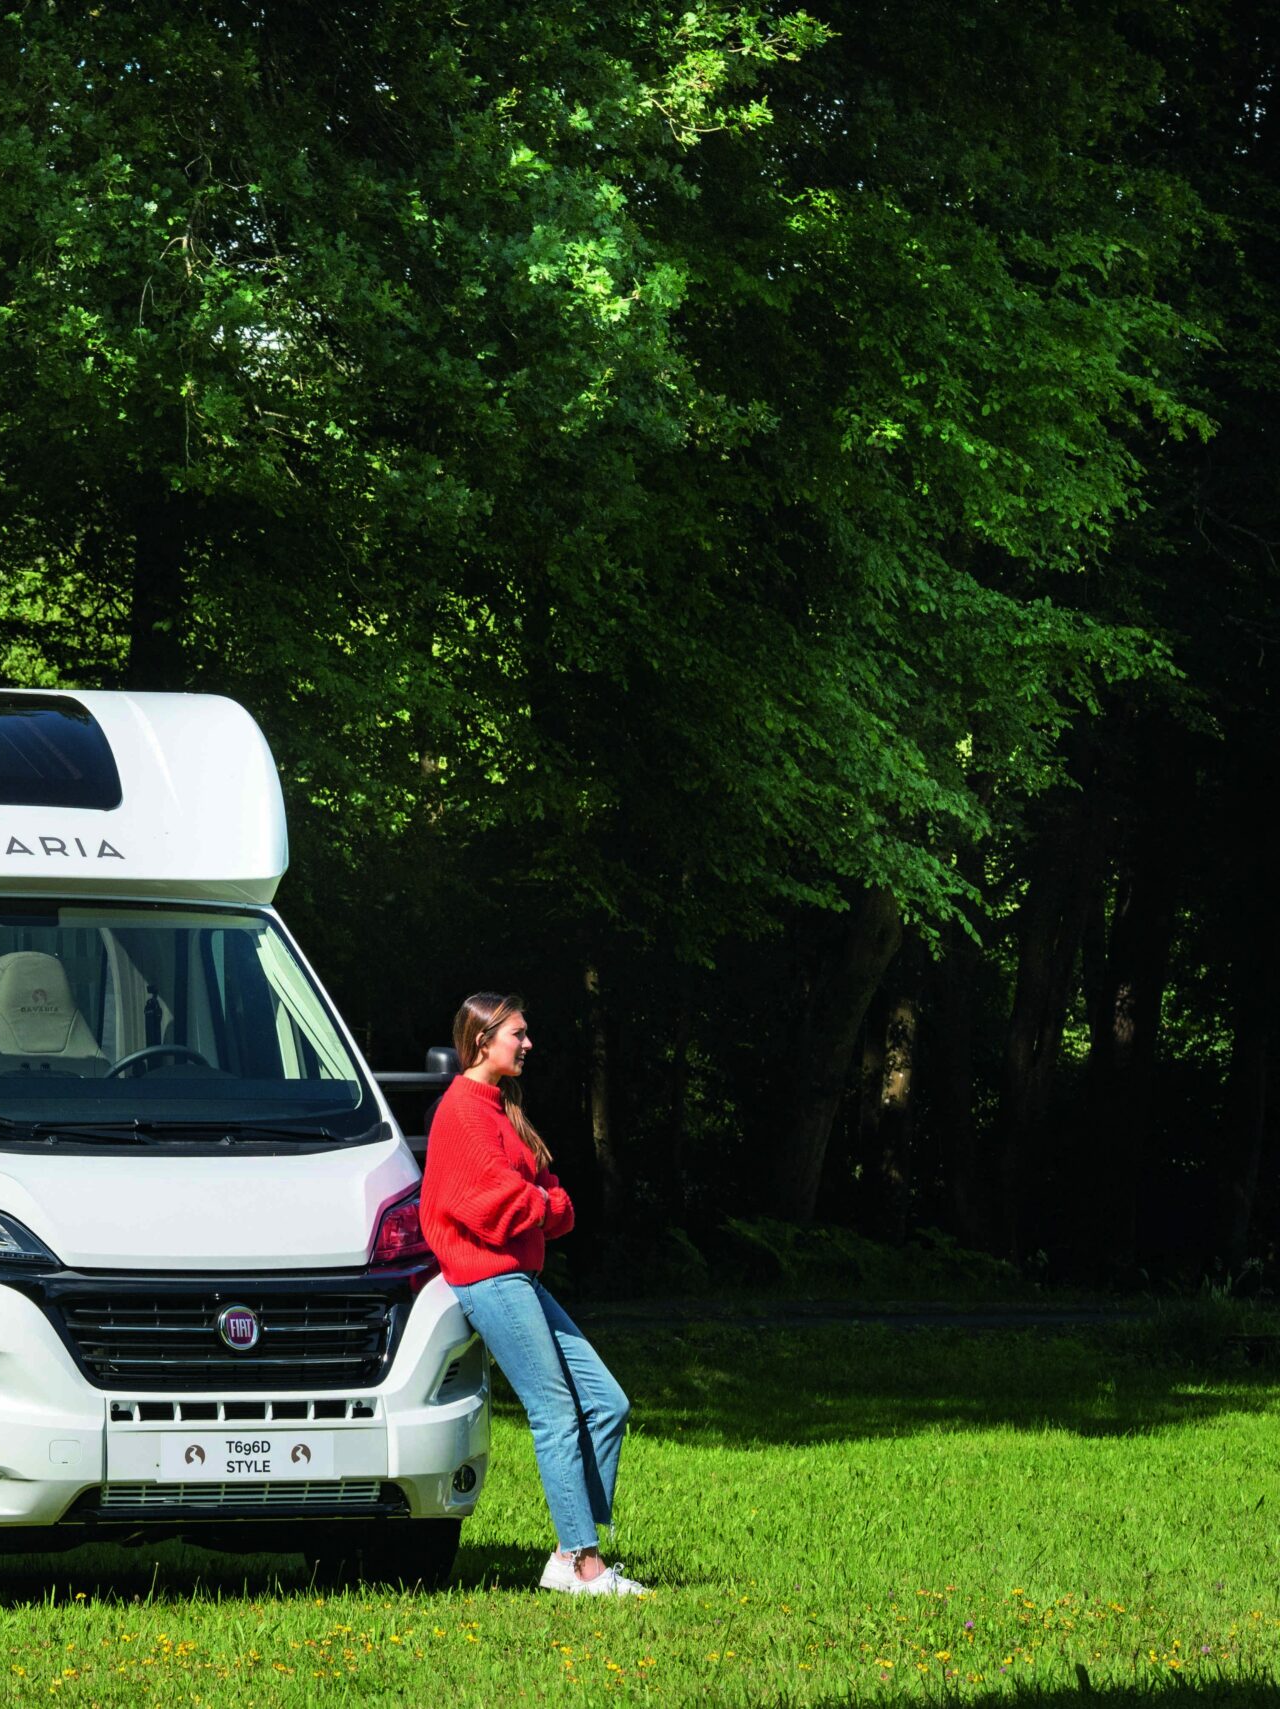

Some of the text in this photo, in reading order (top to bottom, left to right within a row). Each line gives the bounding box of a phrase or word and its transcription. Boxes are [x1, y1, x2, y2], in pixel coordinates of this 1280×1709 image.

[229, 1318, 252, 1338] FIAT
[225, 1440, 271, 1456] T696D
[226, 1460, 271, 1473] STYLE
